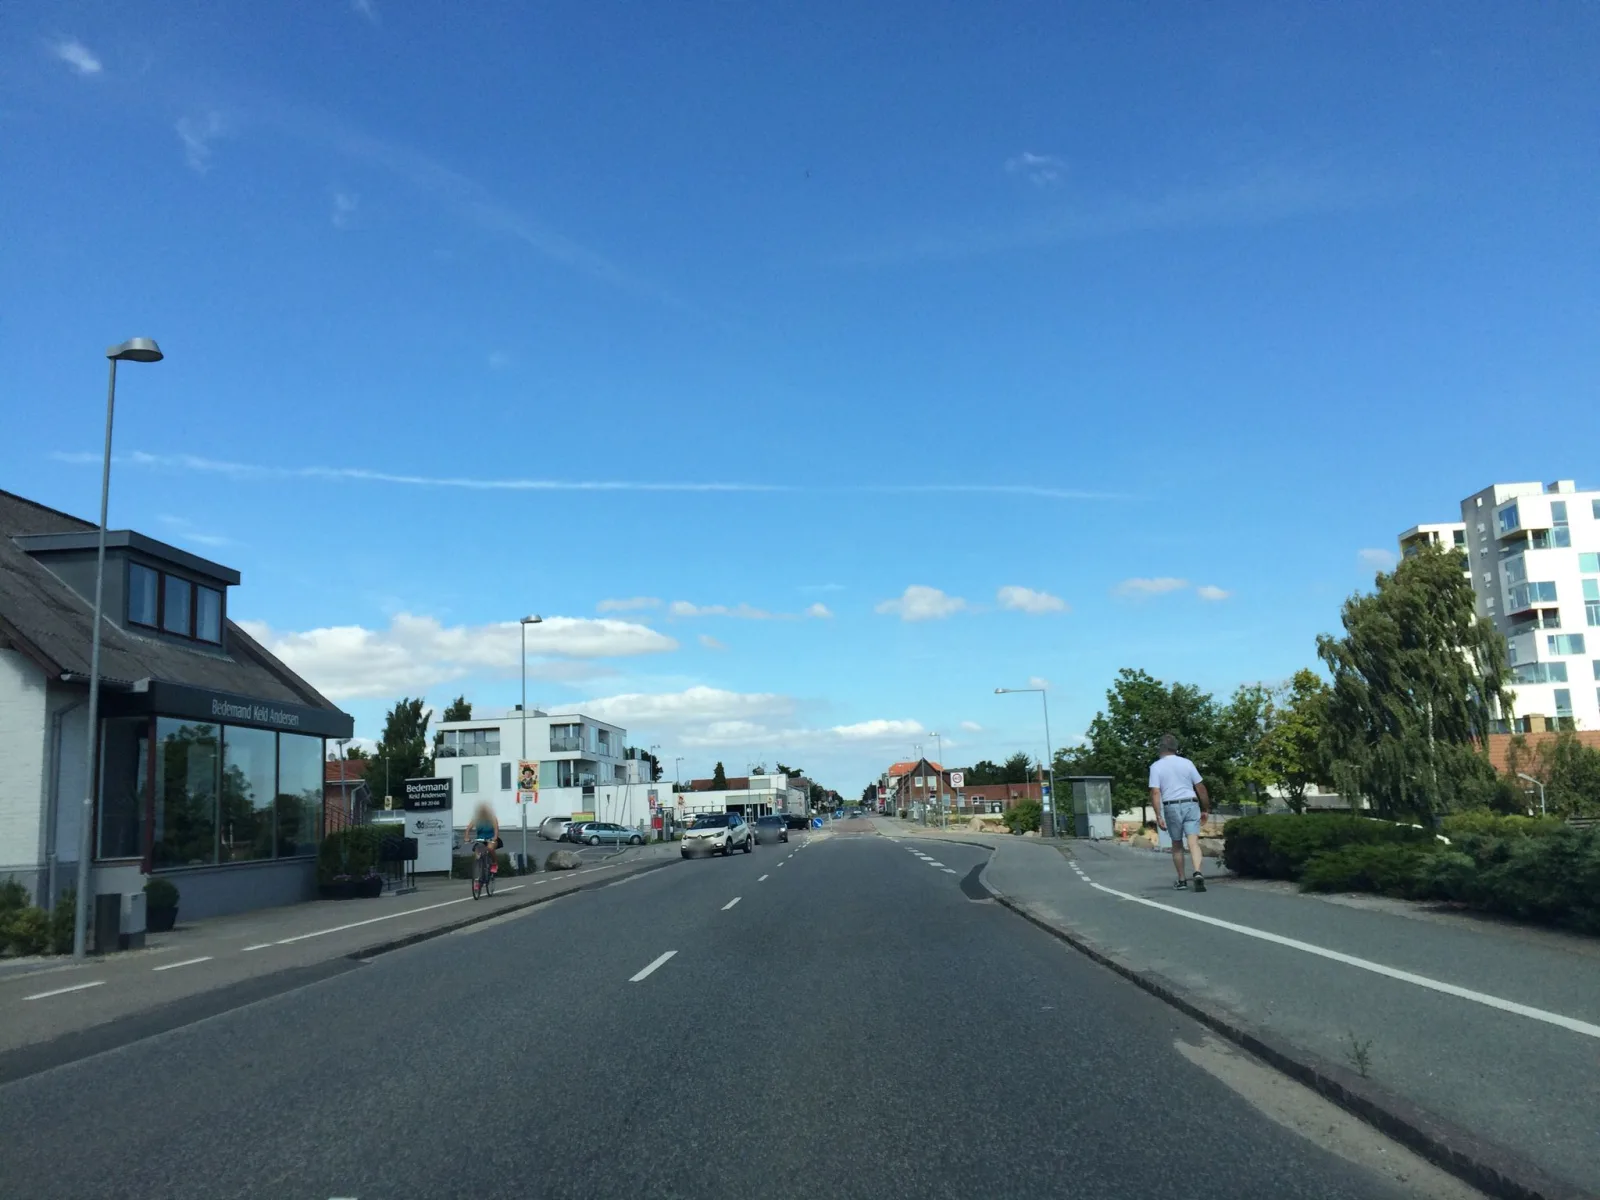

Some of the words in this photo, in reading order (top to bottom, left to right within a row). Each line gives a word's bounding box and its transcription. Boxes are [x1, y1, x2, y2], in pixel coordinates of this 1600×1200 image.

[212, 699, 252, 720] Bedemand
[269, 709, 299, 725] Andersen
[406, 782, 449, 792] Bedemand
